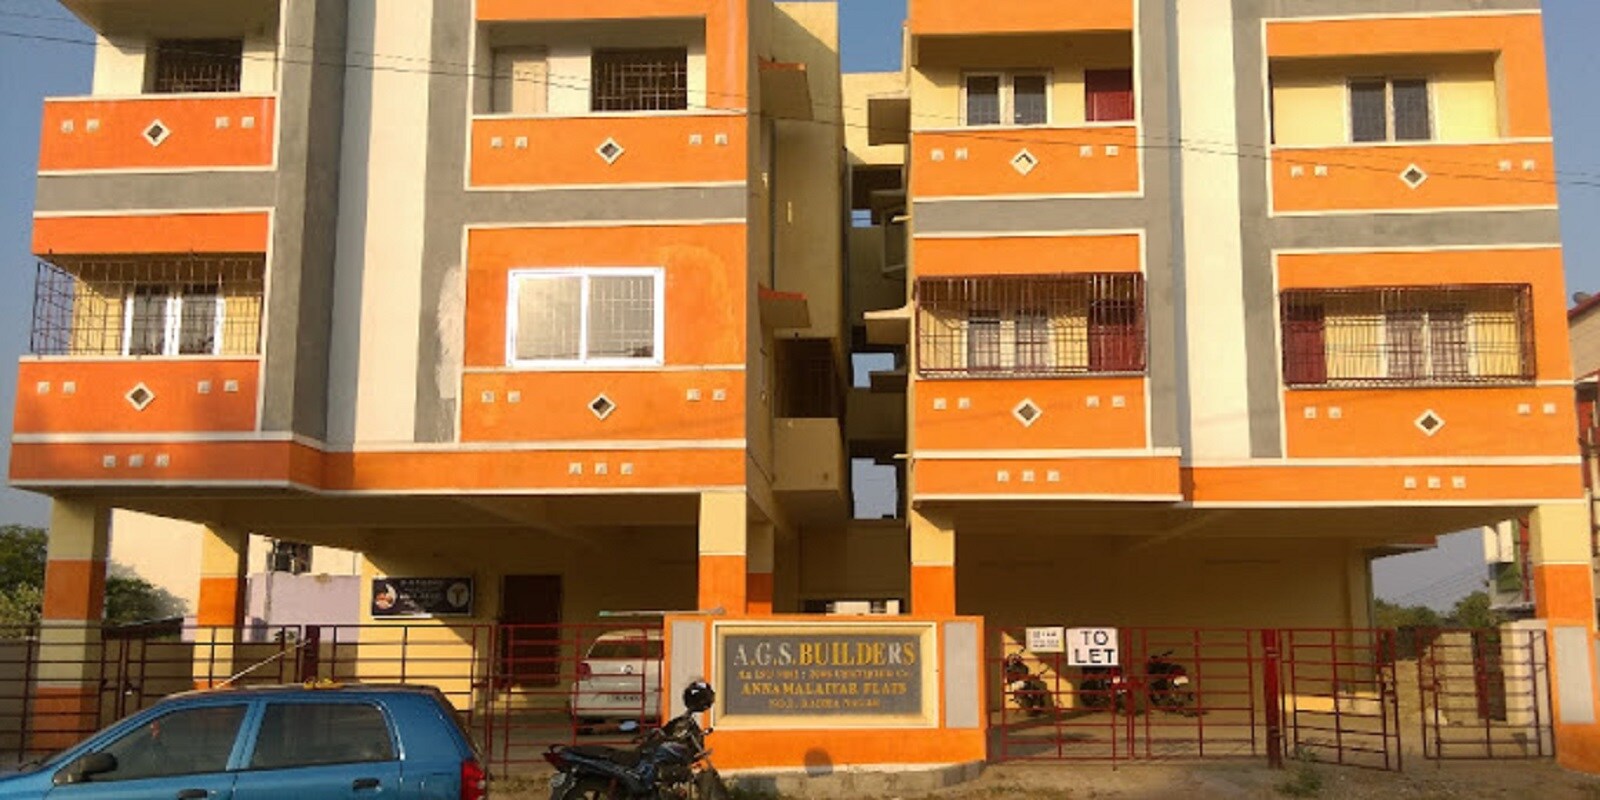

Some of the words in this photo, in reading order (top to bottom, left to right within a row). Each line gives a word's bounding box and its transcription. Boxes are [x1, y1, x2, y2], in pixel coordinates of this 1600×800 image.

[1080, 630, 1109, 645] TO
[1075, 648, 1115, 664] LET
[863, 682, 908, 696] FLATS
